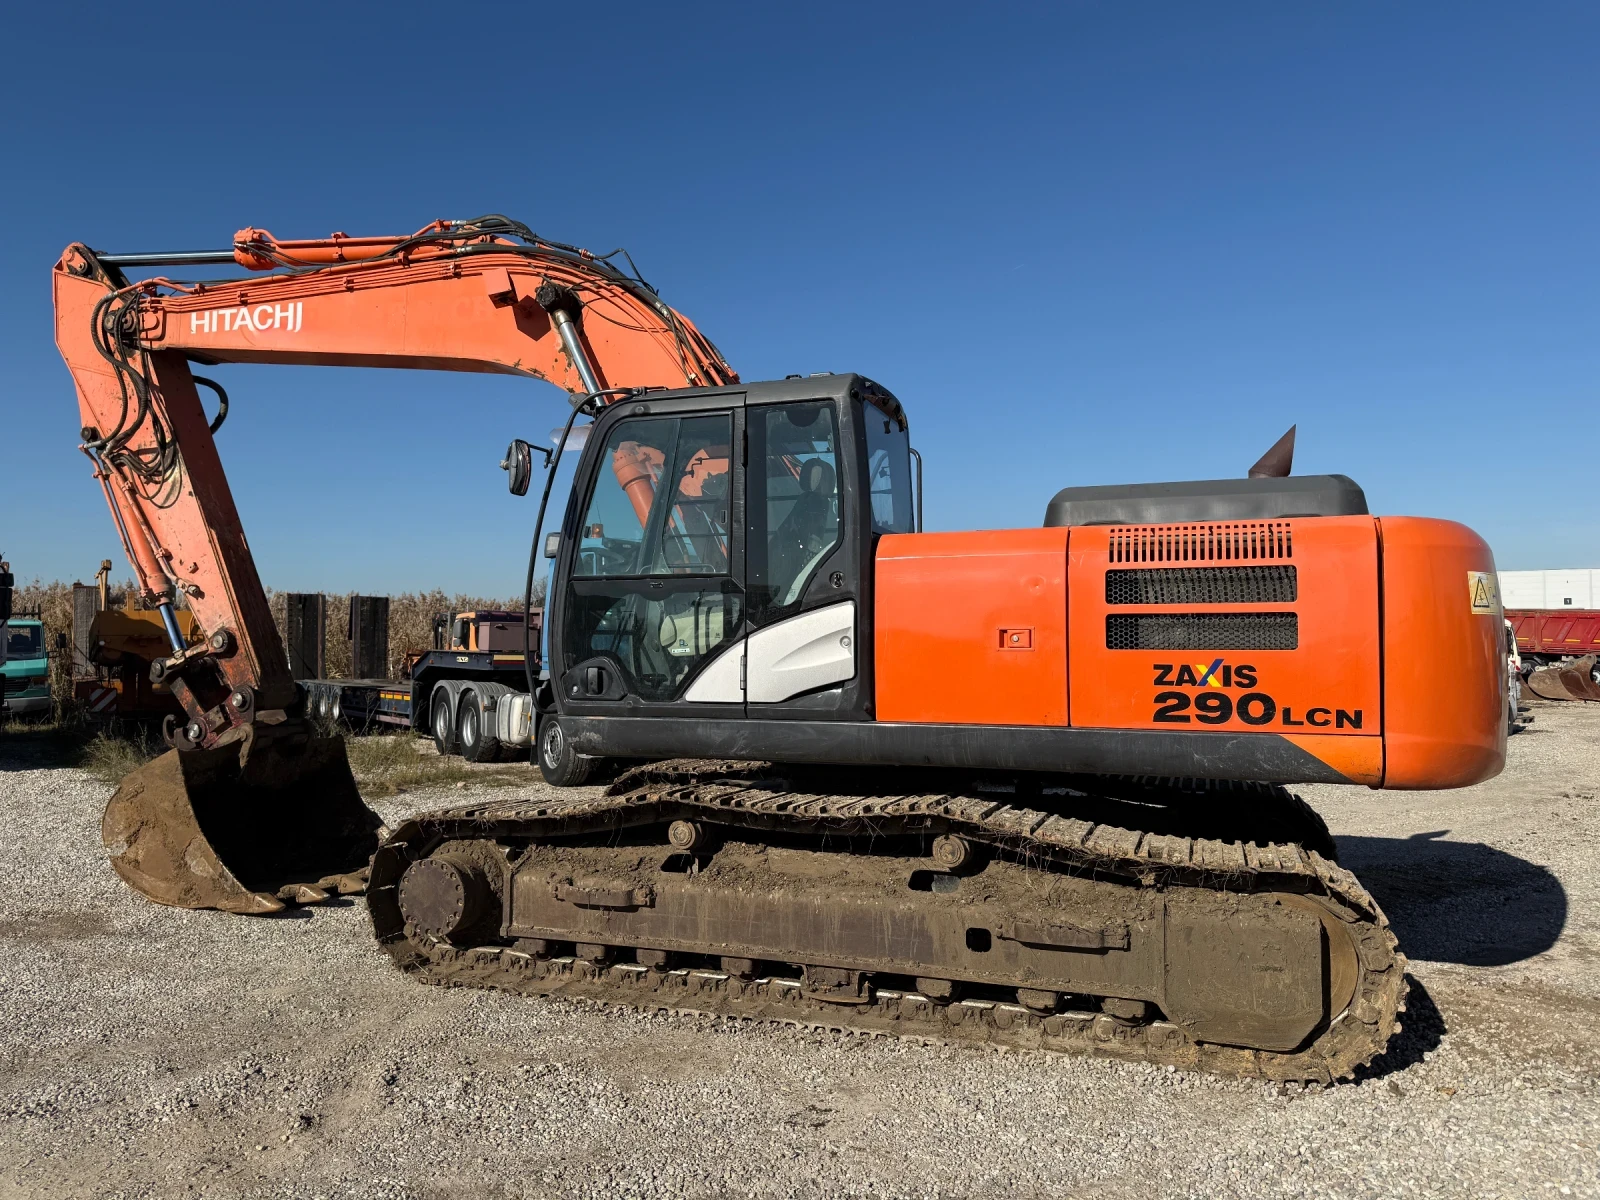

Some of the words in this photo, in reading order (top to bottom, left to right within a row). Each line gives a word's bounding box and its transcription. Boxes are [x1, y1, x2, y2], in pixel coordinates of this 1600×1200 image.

[191, 302, 303, 335] HITACHI
[1153, 658, 1258, 688] ZAXIS
[1152, 691, 1277, 725] 290
[1282, 706, 1363, 729] LCN
